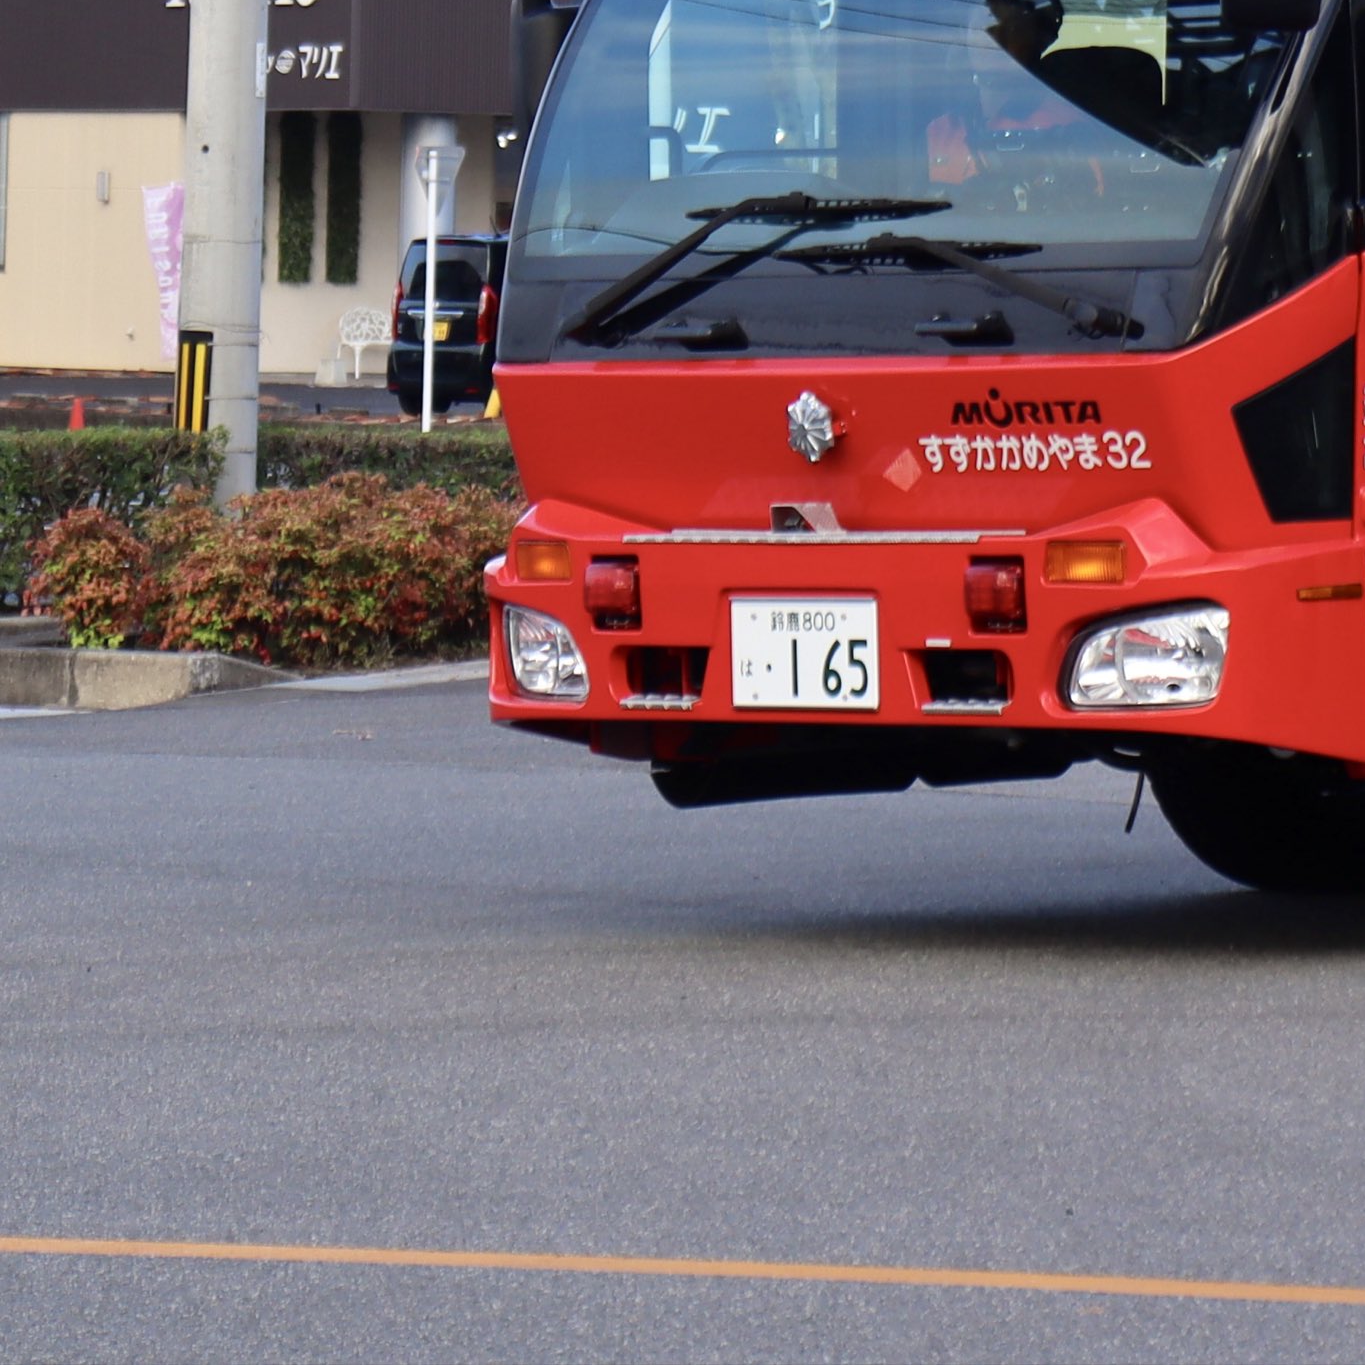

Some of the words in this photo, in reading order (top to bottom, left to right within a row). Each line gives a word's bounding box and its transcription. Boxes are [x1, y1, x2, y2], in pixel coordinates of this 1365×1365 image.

[299, 45, 343, 80] マリエ
[951, 388, 1102, 428] MORITA
[918, 431, 1152, 473] すずかかめやま32
[740, 659, 753, 677] は
